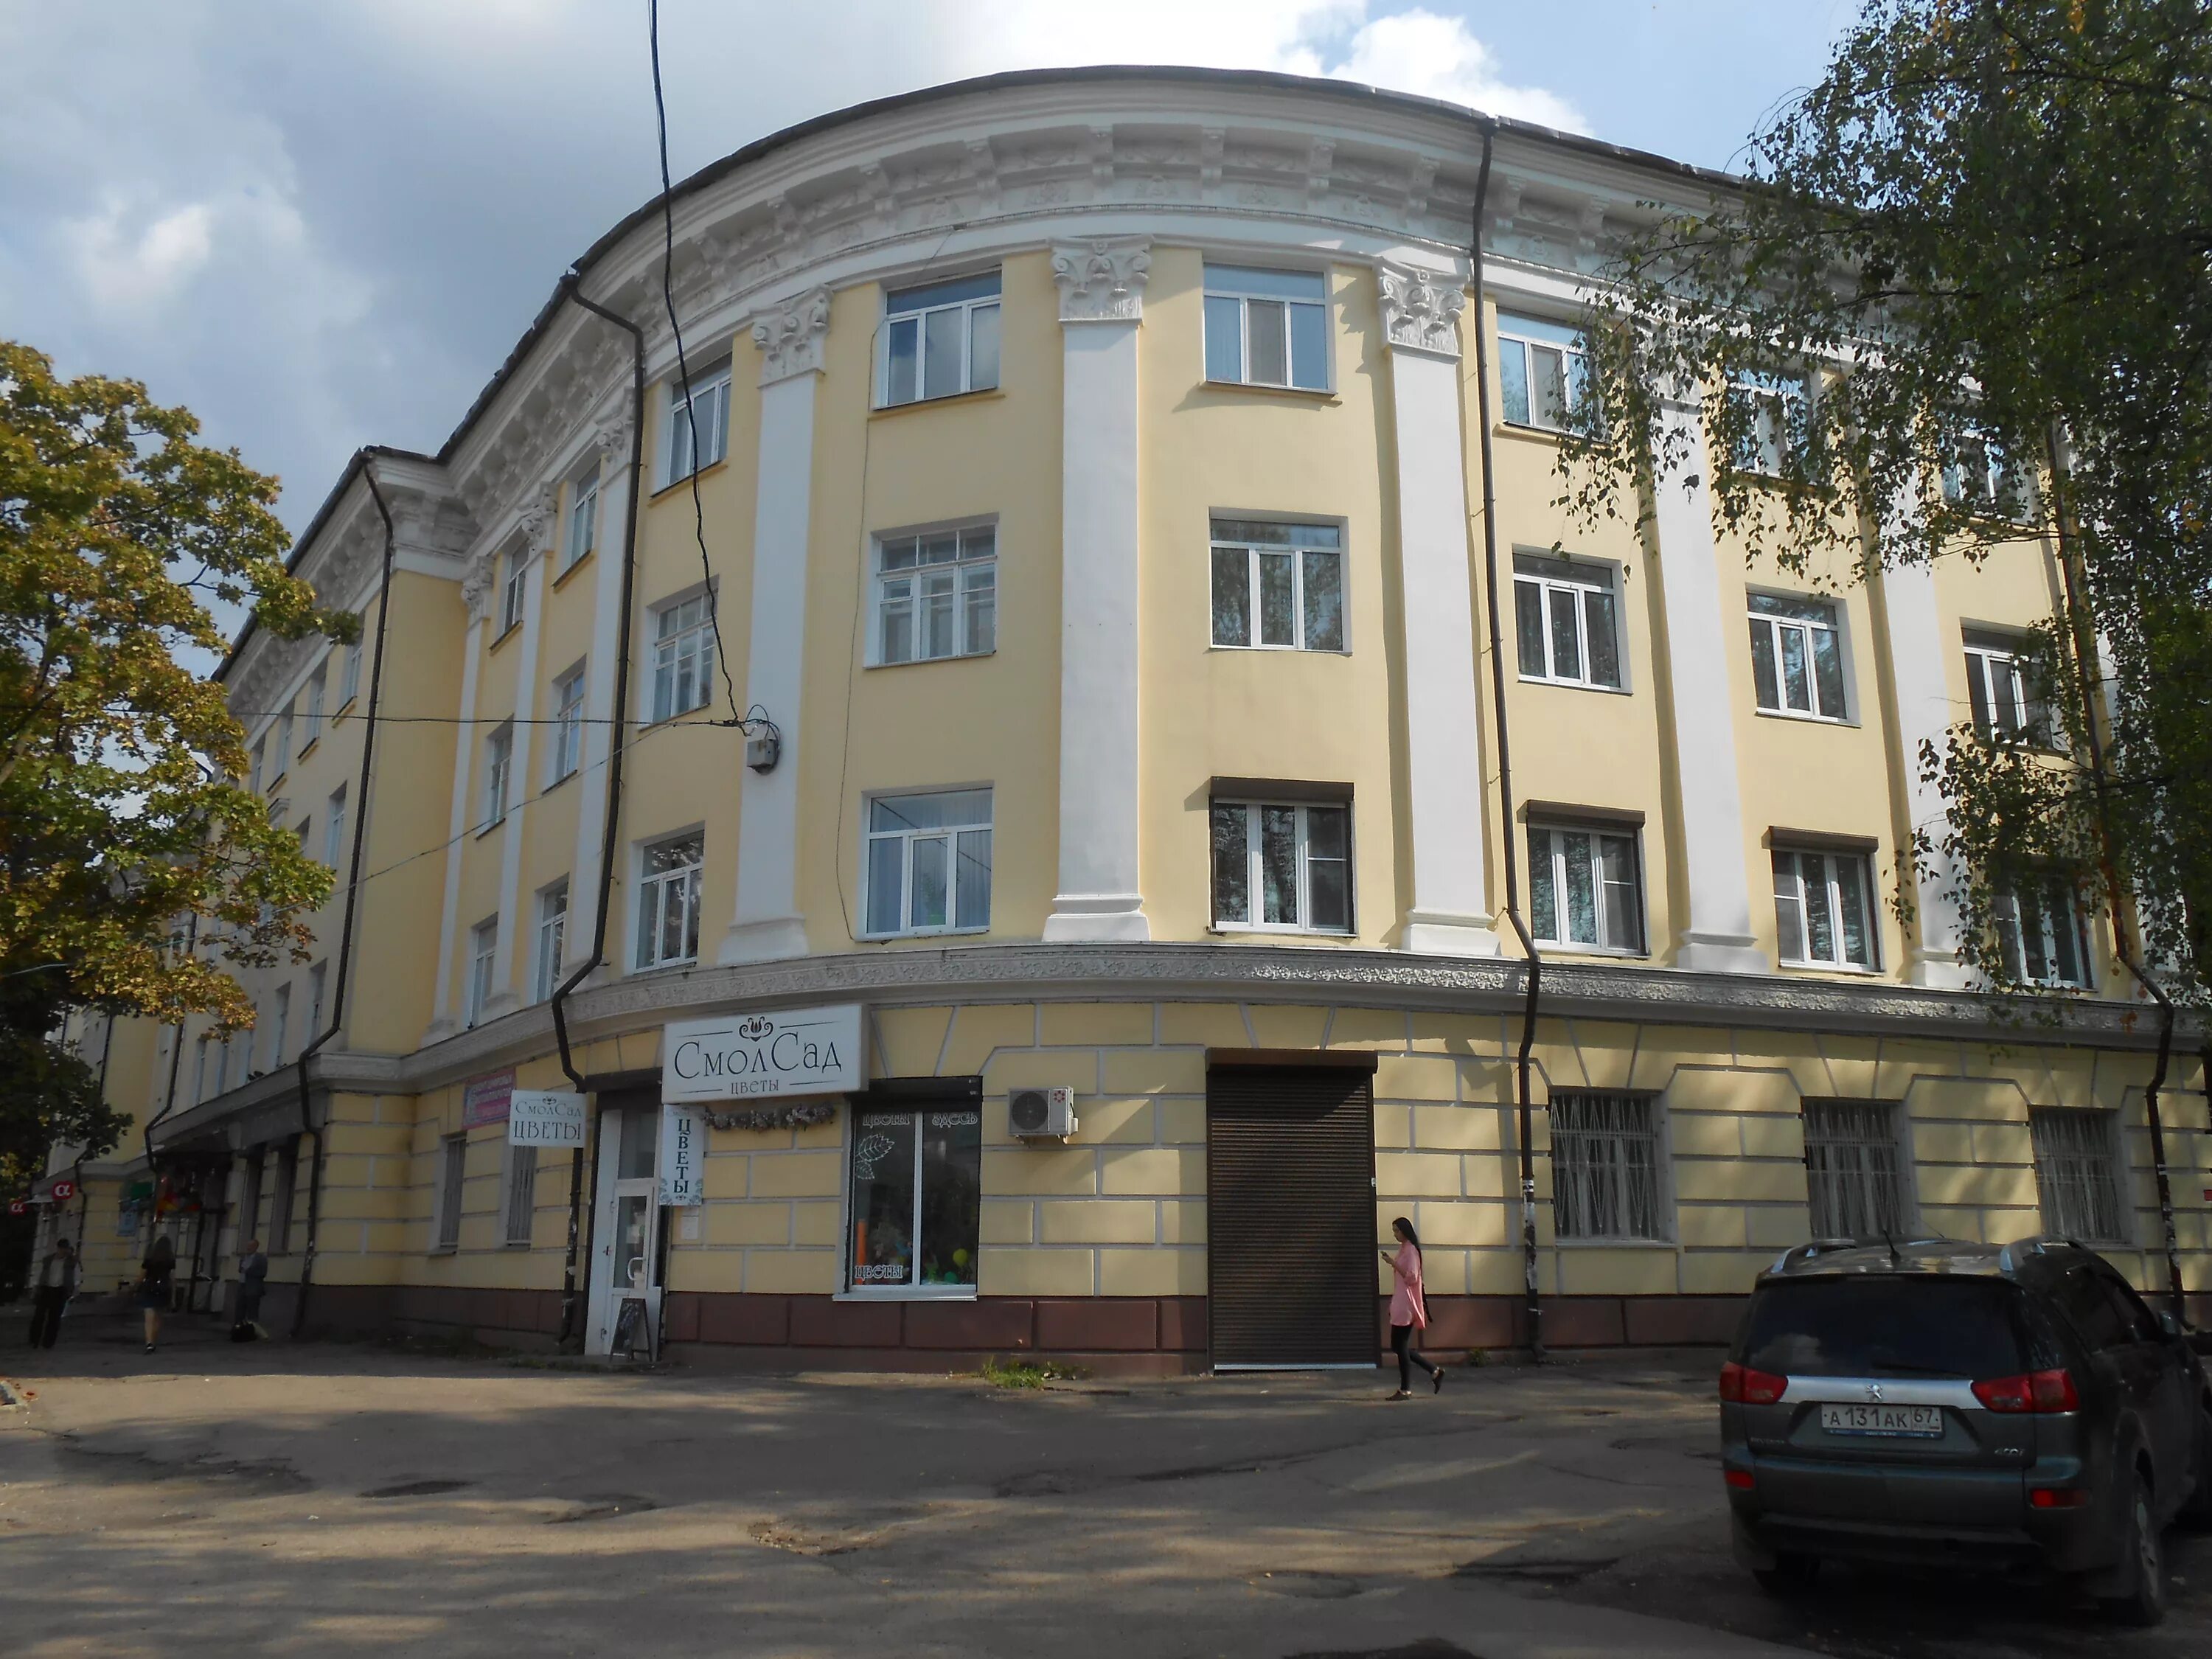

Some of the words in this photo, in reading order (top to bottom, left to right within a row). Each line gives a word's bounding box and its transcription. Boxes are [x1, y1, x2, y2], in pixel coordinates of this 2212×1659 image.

[675, 1032, 842, 1079] СмолСад
[514, 1121, 581, 1141] ЦВЕТЫ
[673, 1119, 691, 1193] ЦВЕТЫ
[1913, 1408, 1933, 1424] 67
